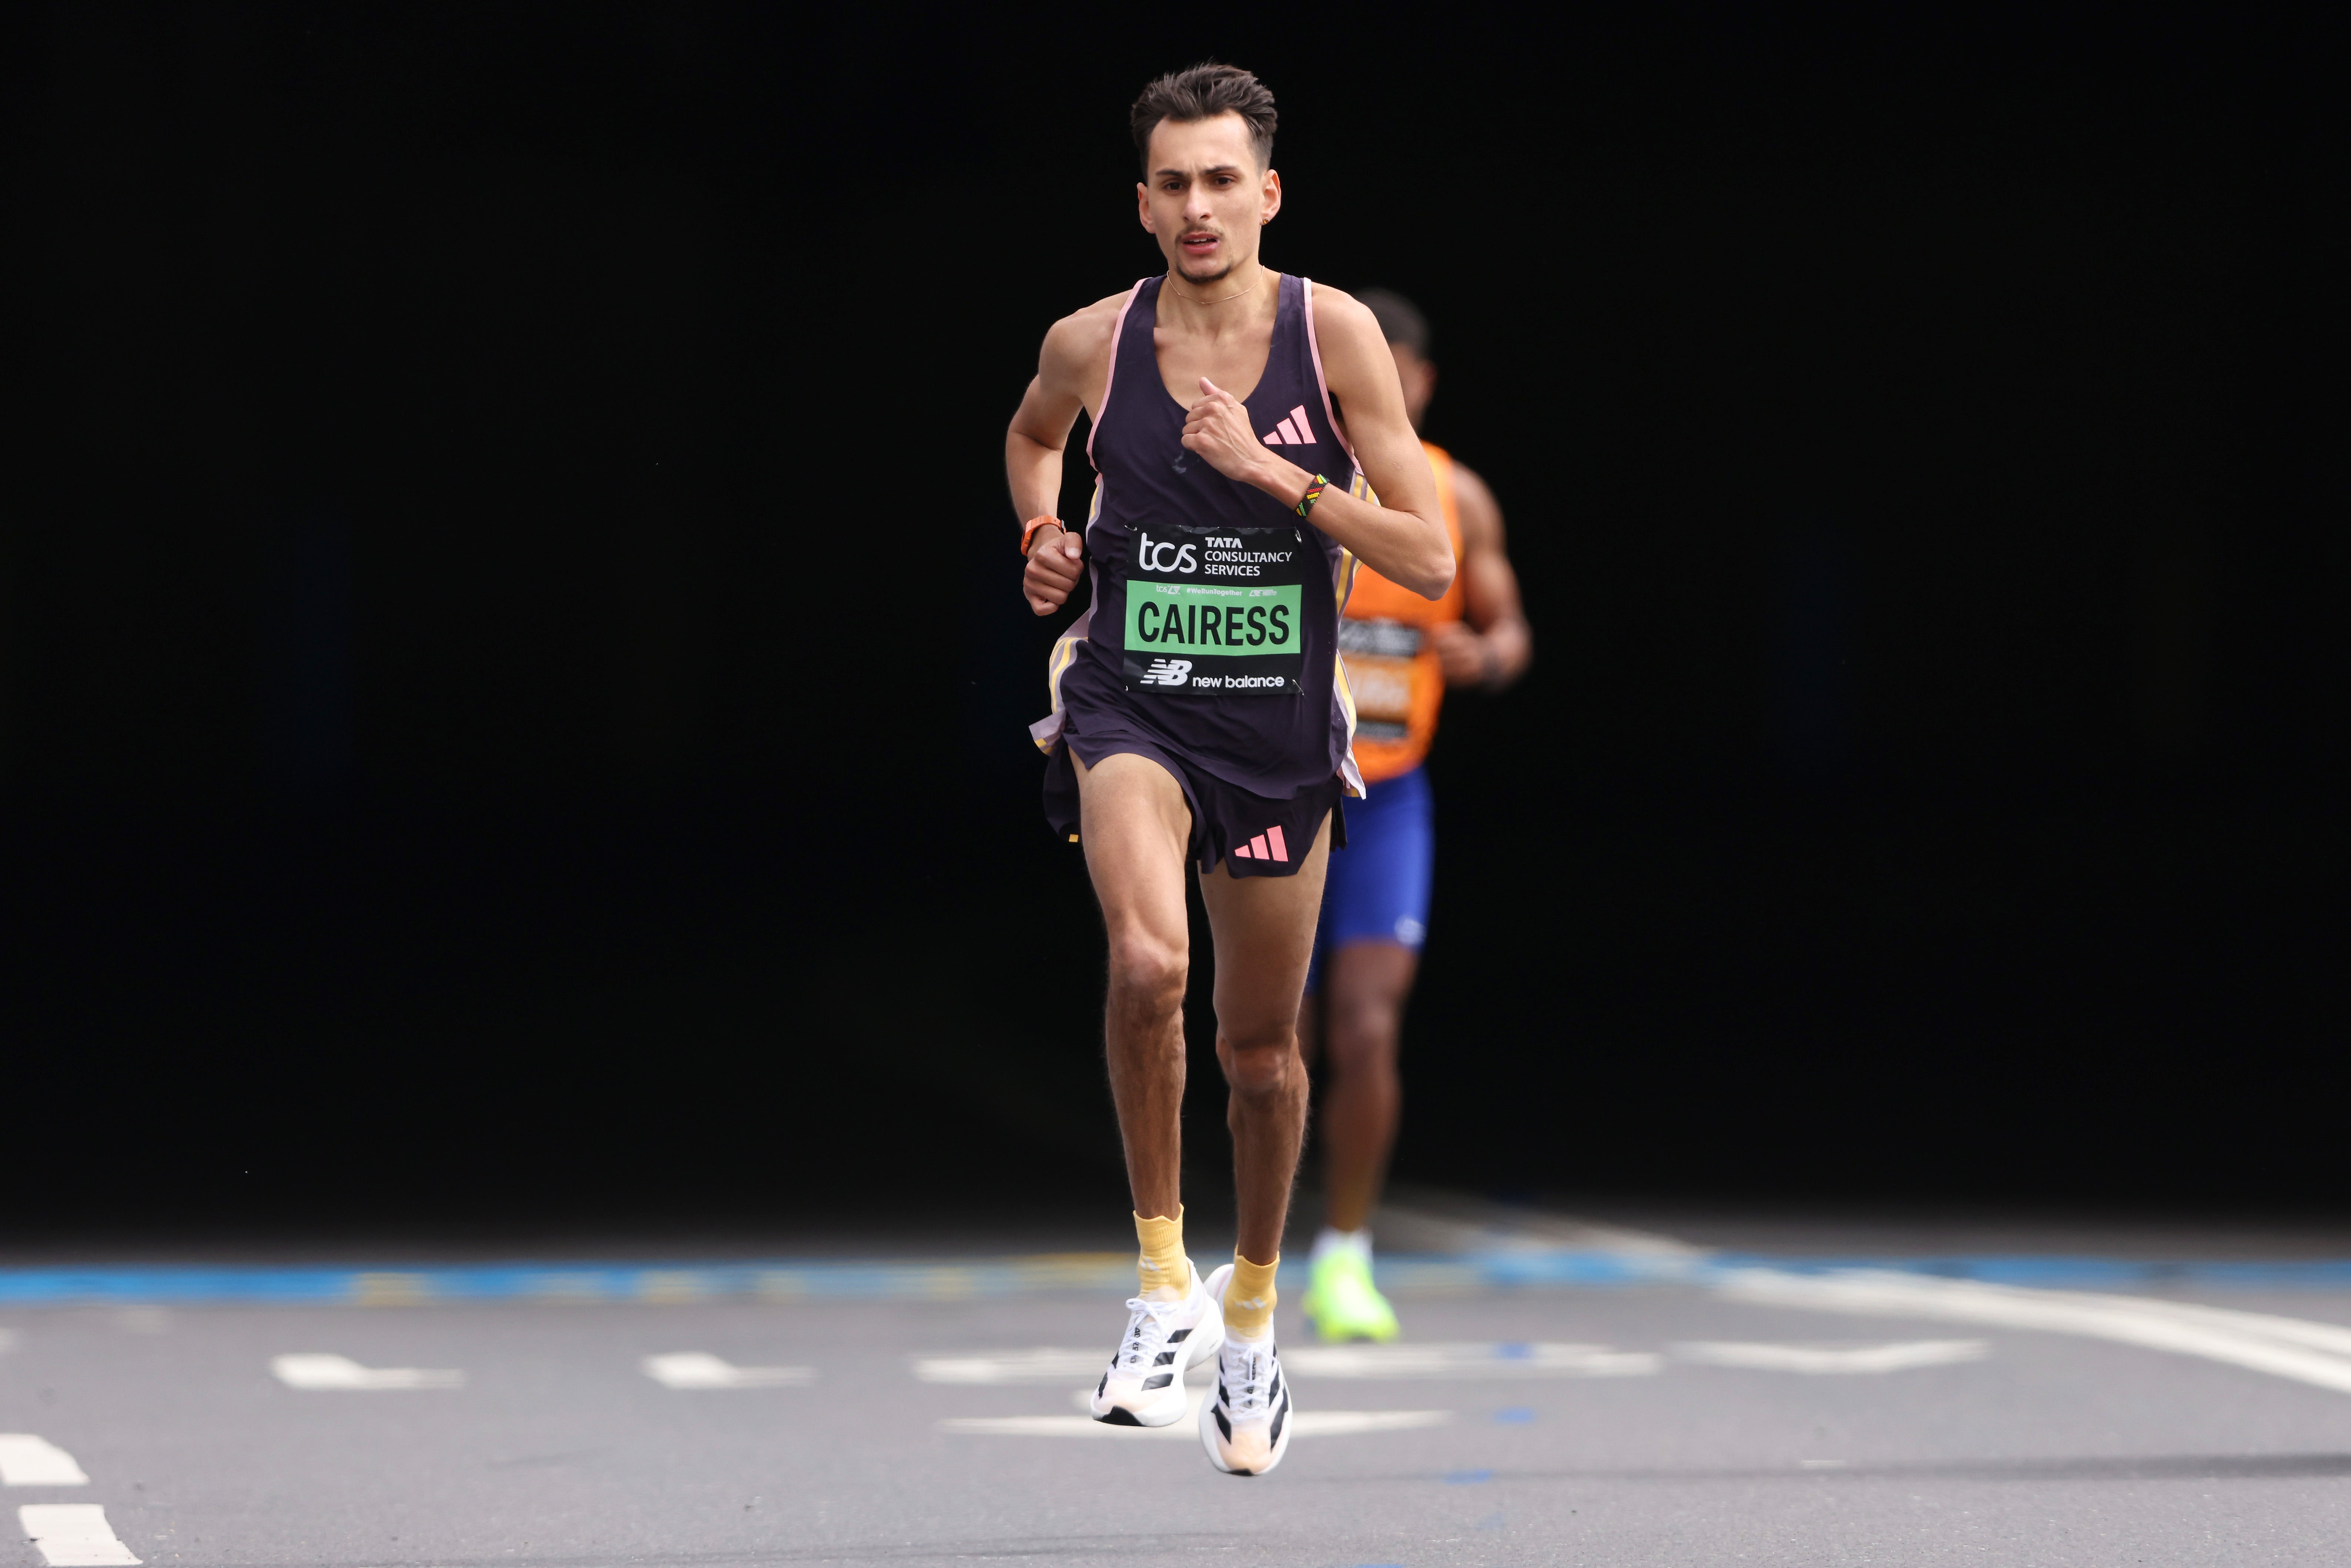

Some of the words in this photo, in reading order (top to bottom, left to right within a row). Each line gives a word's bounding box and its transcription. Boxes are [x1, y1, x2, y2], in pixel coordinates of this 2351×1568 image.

[1205, 537, 1243, 548] TATA
[1139, 532, 1197, 573] tcs
[1205, 551, 1292, 562] CONSULTANCY
[1205, 564, 1260, 576] SERVICES
[1186, 587, 1243, 596] #WeRunTogether
[1138, 602, 1289, 646] CAIRESS
[1193, 677, 1222, 688] new
[1225, 675, 1285, 688] balance
[1130, 1327, 1140, 1363] ADZEO
